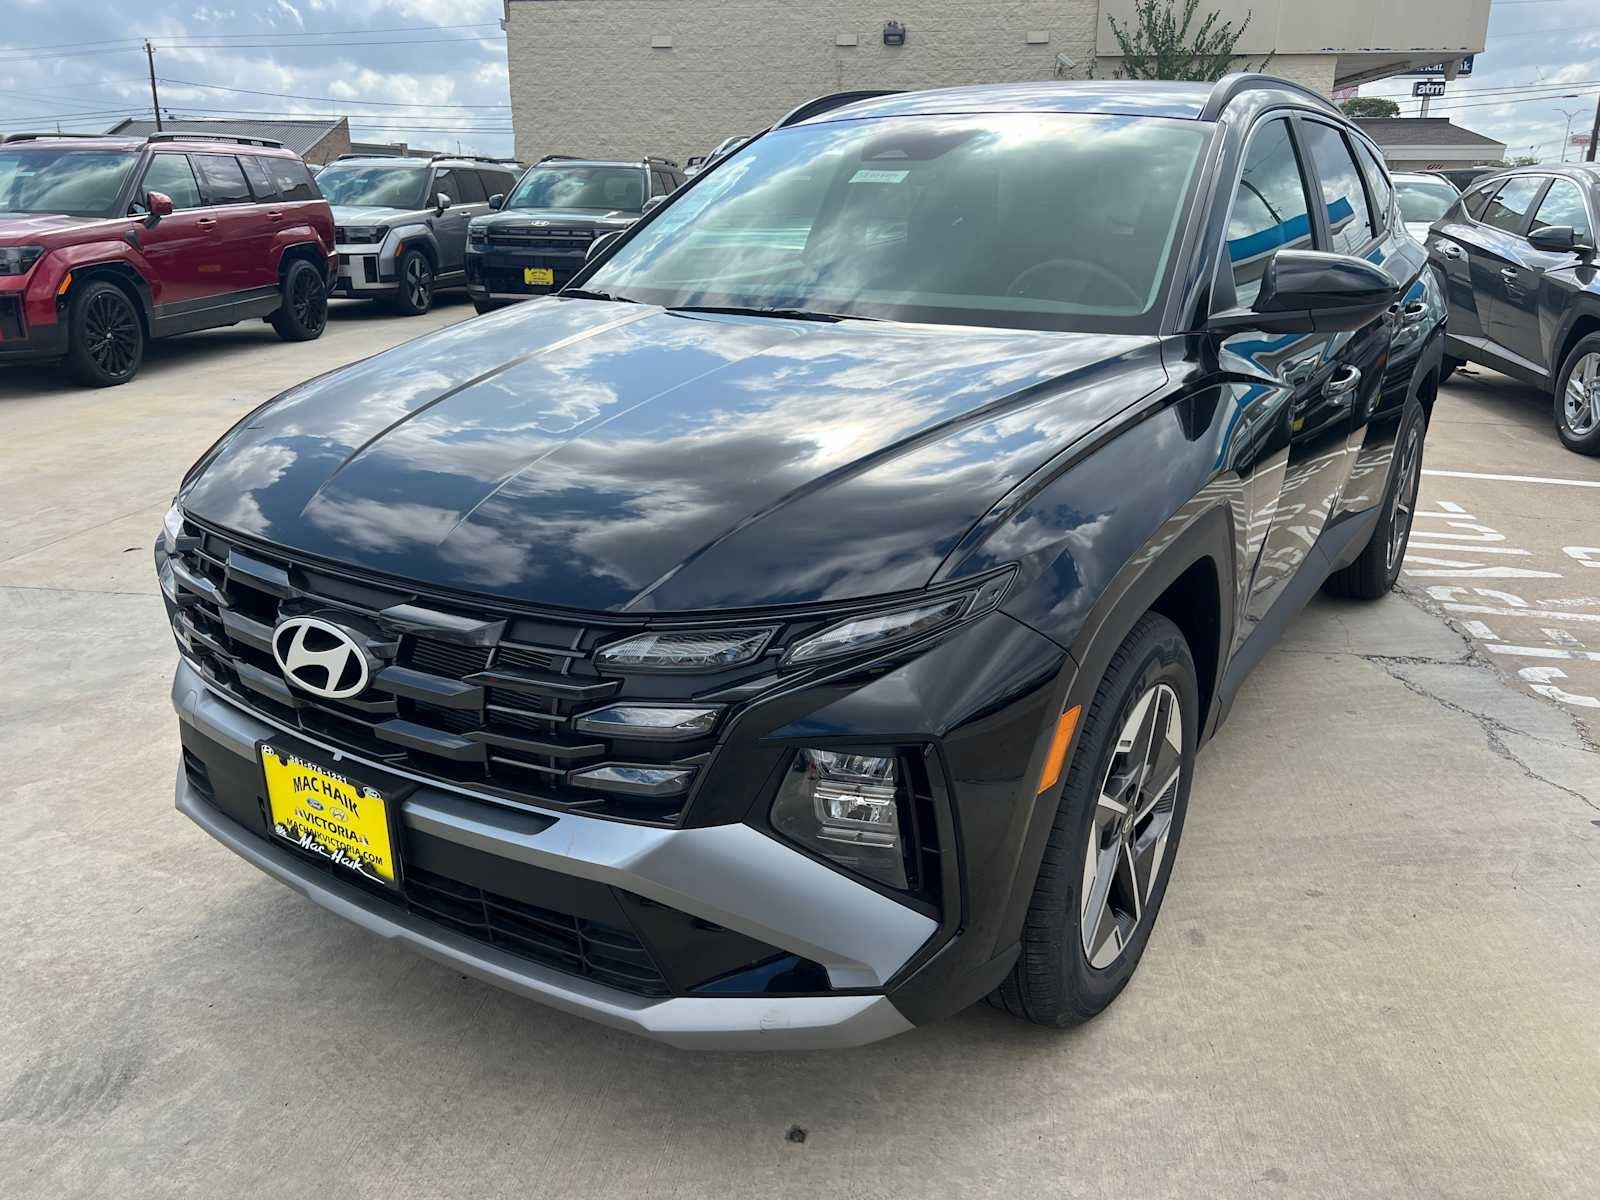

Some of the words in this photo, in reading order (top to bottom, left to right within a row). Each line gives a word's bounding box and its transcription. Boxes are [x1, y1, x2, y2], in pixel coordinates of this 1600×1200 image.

[1417, 83, 1444, 95] atm
[293, 776, 319, 793] MAC
[322, 782, 360, 818] HAIK
[303, 811, 359, 843] VICTORIA
[299, 835, 329, 857] Mac
[330, 850, 365, 870] Haik
